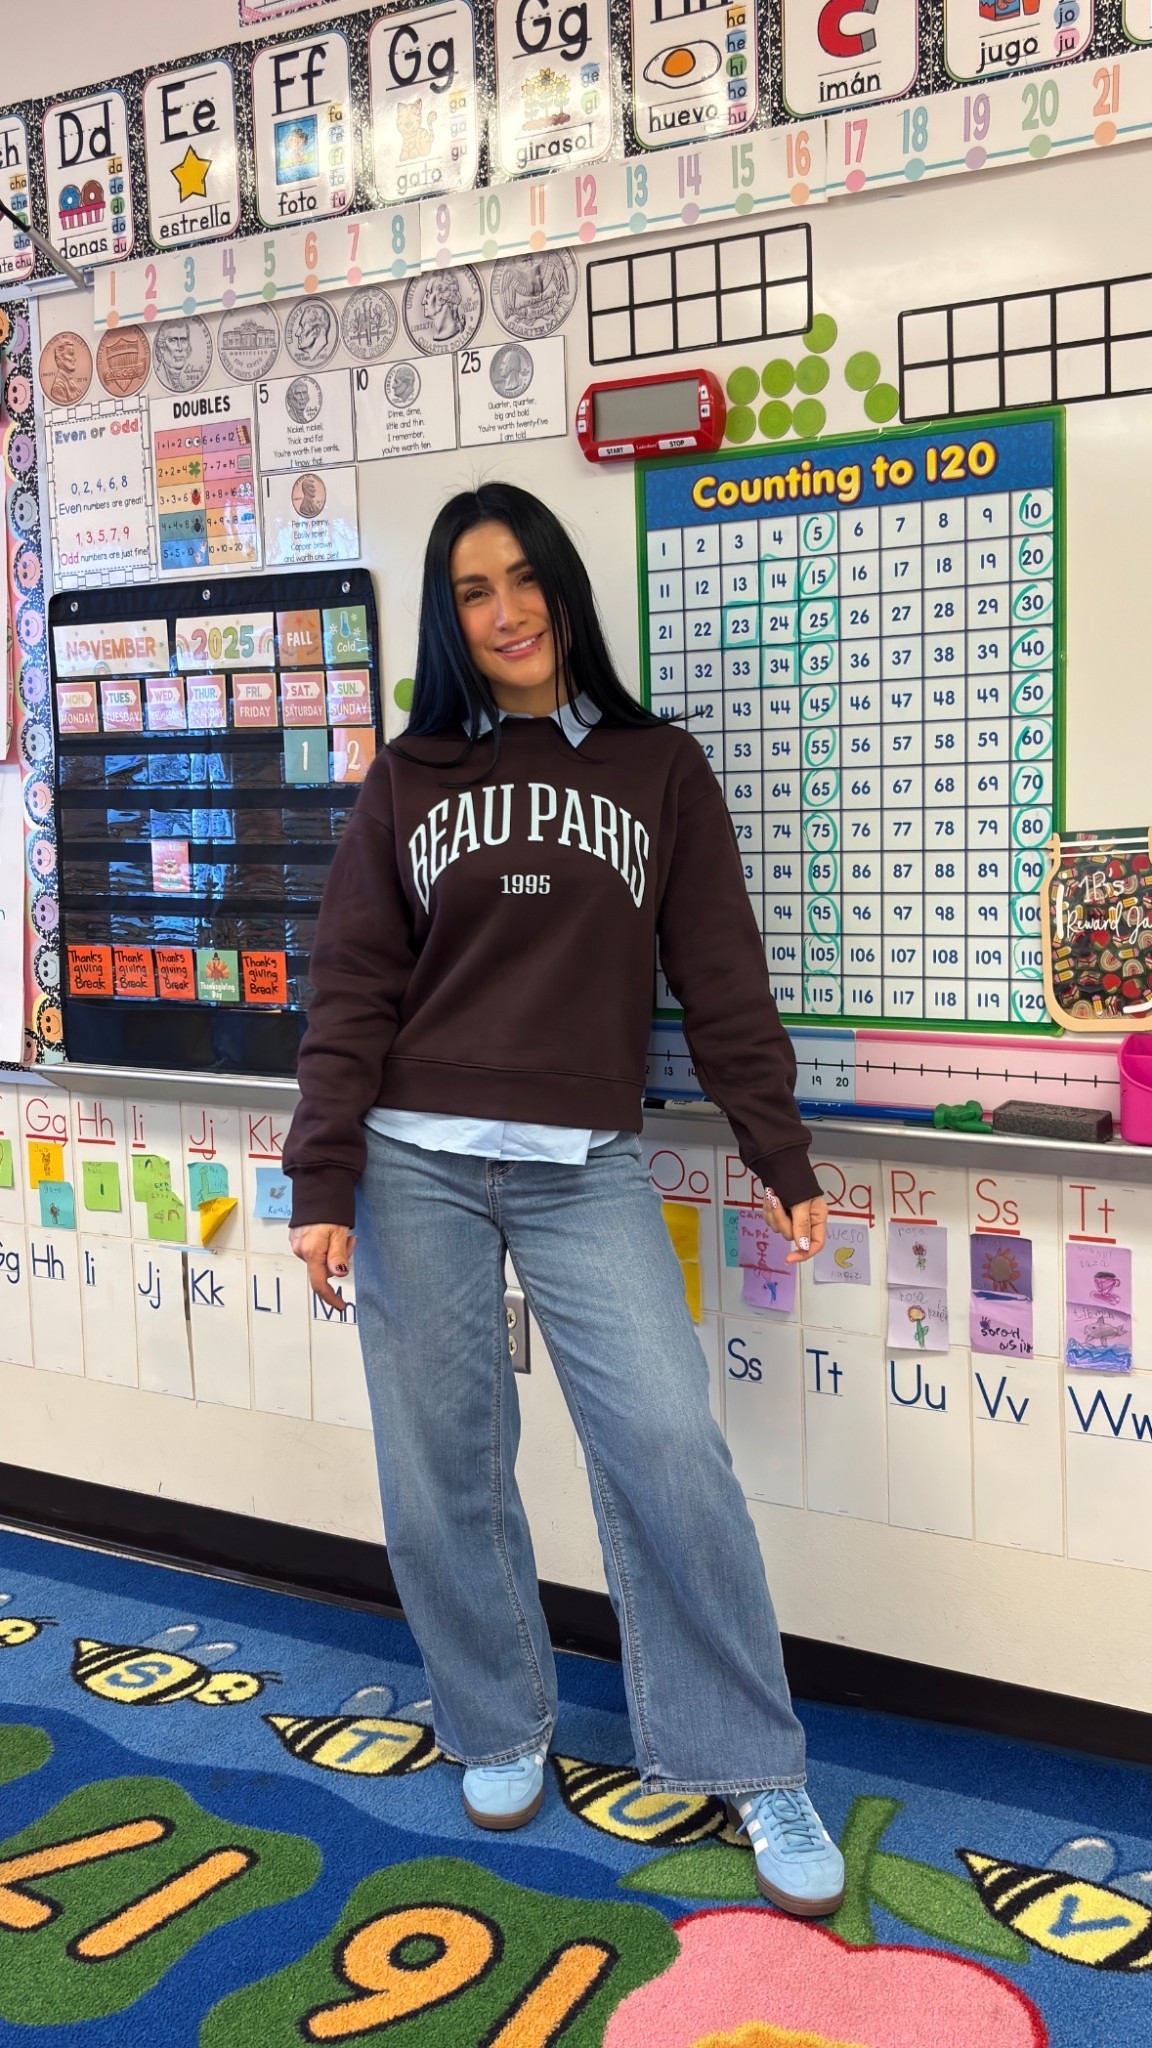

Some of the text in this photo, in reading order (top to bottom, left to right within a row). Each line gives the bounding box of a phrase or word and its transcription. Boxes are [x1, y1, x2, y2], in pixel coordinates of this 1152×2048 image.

[727, 9, 746, 26] ha
[727, 34, 746, 50] he
[1056, 34, 1075, 57] ju
[389, 25, 455, 94] Gg
[730, 57, 744, 74] hi
[976, 36, 1038, 73] jugo
[274, 46, 326, 114] Ff
[728, 81, 747, 99] ho
[819, 71, 881, 102] imán
[162, 82, 216, 141] Ee
[649, 104, 718, 132] huevo
[728, 105, 747, 125] hu
[59, 102, 112, 166] Dd
[517, 123, 594, 169] girasol
[109, 159, 122, 174] da
[110, 64, 1120, 306] 1 2 3 4 5 6 7 8 9 10 11 12 13 14 15 16 17 18 19 20 21
[110, 180, 123, 195] de
[397, 163, 442, 194] gato
[278, 191, 317, 216] foto
[113, 219, 126, 233] do
[160, 204, 231, 239] estrella
[60, 237, 108, 259] donas
[461, 351, 481, 374] 25
[356, 371, 369, 392] 10
[259, 384, 269, 404] 5
[173, 396, 230, 419] DOUBLES
[55, 418, 139, 444] Even or Odd
[606, 446, 623, 455] START
[669, 439, 685, 448] STOP
[692, 440, 997, 509] Counting to 120
[266, 478, 271, 498] 1
[59, 503, 82, 517] Even
[83, 498, 110, 512] numbers
[112, 500, 124, 508] are
[662, 502, 1042, 557] 1 2 3 4 5 6 7 8 9 10
[60, 552, 79, 567] Odd
[80, 551, 108, 564] numbers
[109, 551, 120, 560] are
[121, 549, 132, 561] just
[65, 625, 254, 662] NOVEMBER 2025
[287, 631, 312, 647] FALL
[337, 641, 356, 653] Cold
[108, 691, 133, 704] TUES.
[154, 690, 176, 702] WED.
[193, 688, 218, 700] THUR.
[245, 685, 263, 698] FRI.
[291, 684, 314, 698] SAT.
[337, 682, 359, 695] SUN.
[65, 695, 88, 707] MON.
[240, 706, 271, 718] FRIDAY
[285, 704, 323, 718] SATURDAY
[331, 703, 368, 716] SUNDAY
[60, 711, 94, 725] MONDAY
[104, 711, 141, 724] TUESDAY
[302, 741, 309, 772] 1
[347, 740, 360, 771] 2
[409, 783, 649, 915] BEAU PARIS
[500, 874, 551, 895] 1995
[1067, 901, 1123, 937] Reward
[69, 950, 103, 964] Thanks
[242, 954, 278, 969] Thanks
[74, 964, 103, 978] giving
[249, 968, 278, 984] giving
[75, 976, 106, 991] Break
[200, 981, 236, 993] Thanksgiving
[211, 990, 222, 999] Day
[250, 981, 279, 995] Break
[813, 988, 1000, 1008] 115 116 117 118 119
[664, 1066, 674, 1077] 13
[811, 1074, 849, 1089] 19 20
[26, 1098, 68, 1147] Gg
[77, 1101, 113, 1138] Hh
[133, 1105, 144, 1141] Ii
[190, 1111, 215, 1160] Jj
[249, 1115, 283, 1151] Kk
[649, 1150, 709, 1194] Oo
[891, 1170, 936, 1216] Rr
[976, 1178, 1019, 1226] Ss
[1069, 1185, 1115, 1233] Tt
[32, 1243, 64, 1279] Hh
[85, 1251, 95, 1285] Ii
[138, 1261, 160, 1309] Jj
[191, 1268, 225, 1306] Kk
[254, 1275, 281, 1313] Ll
[728, 1338, 762, 1381] Ss
[806, 1348, 843, 1393] Tt
[890, 1360, 946, 1410] Uu
[975, 1372, 1029, 1422] Vv
[104, 1659, 173, 1690] S
[335, 1726, 410, 1764] T
[1047, 1893, 1131, 1938] V
